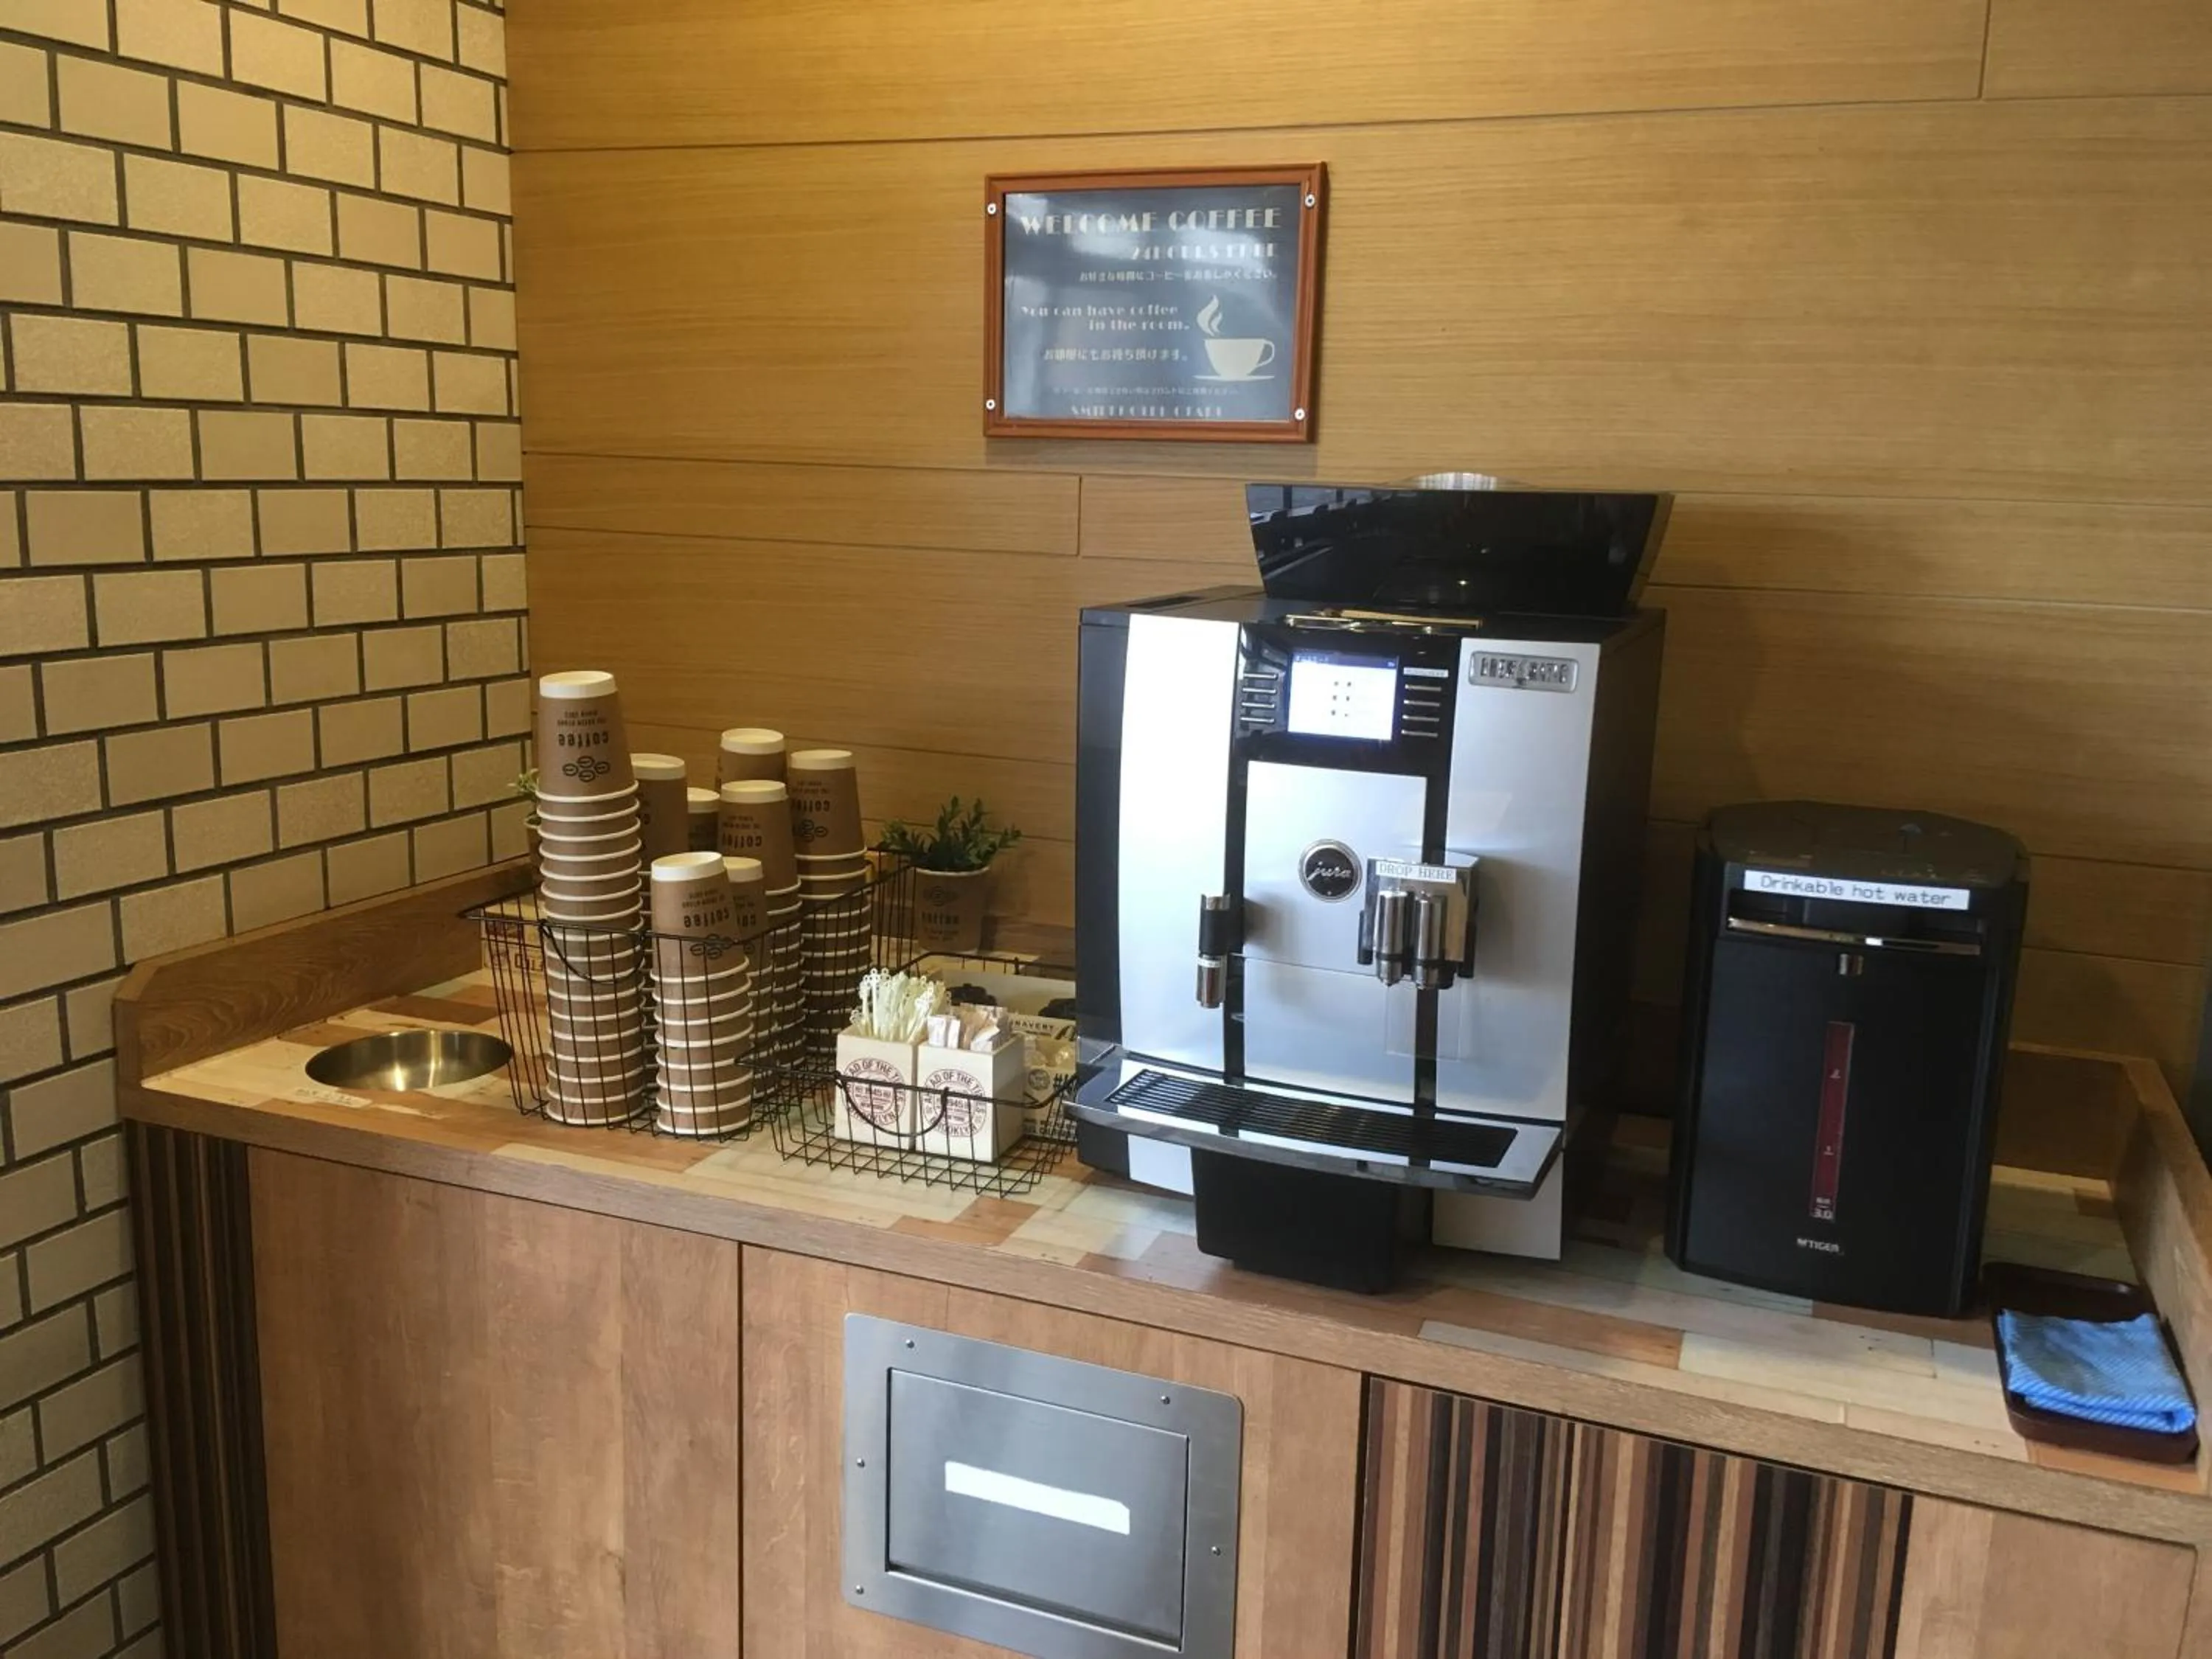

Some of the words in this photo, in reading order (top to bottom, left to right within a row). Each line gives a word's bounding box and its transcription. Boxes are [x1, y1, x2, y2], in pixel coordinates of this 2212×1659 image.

[1020, 212, 1157, 236] WELCOME
[1168, 207, 1281, 232] COFFEE
[1054, 306, 1082, 317] can
[1086, 304, 1125, 317] have
[1130, 304, 1178, 316] coffee
[1379, 861, 1413, 877] DROP
[1419, 866, 1454, 880] HERE
[1760, 874, 1844, 896] Drinkable
[1852, 883, 1885, 900] hot
[1894, 889, 1952, 905] water
